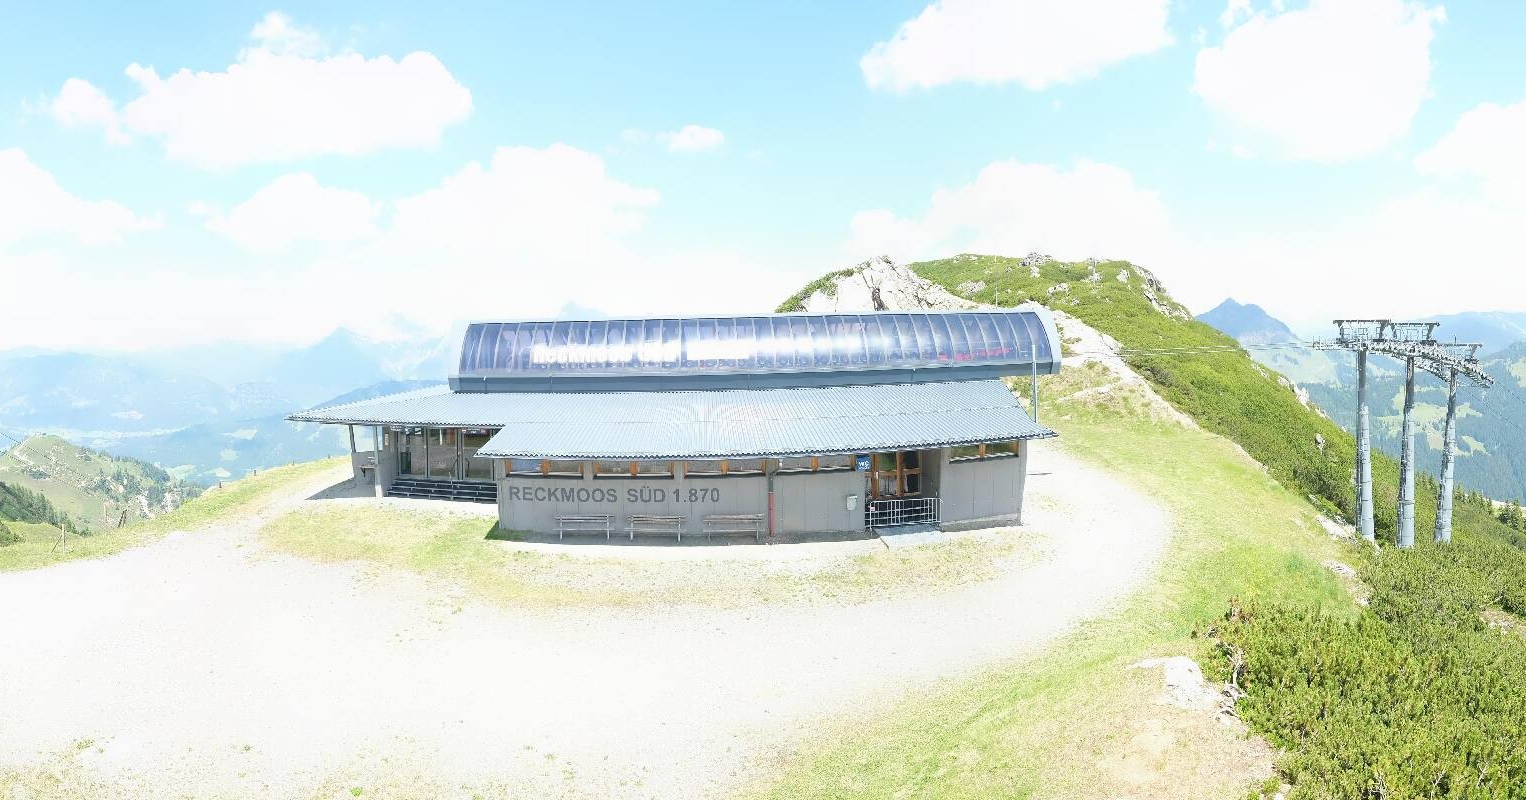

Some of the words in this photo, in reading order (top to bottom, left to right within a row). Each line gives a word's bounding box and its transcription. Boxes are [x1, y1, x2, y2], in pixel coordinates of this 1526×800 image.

[509, 486, 618, 503] RECKMOOS
[626, 486, 666, 503] SÜD
[673, 487, 720, 503] 1.870
